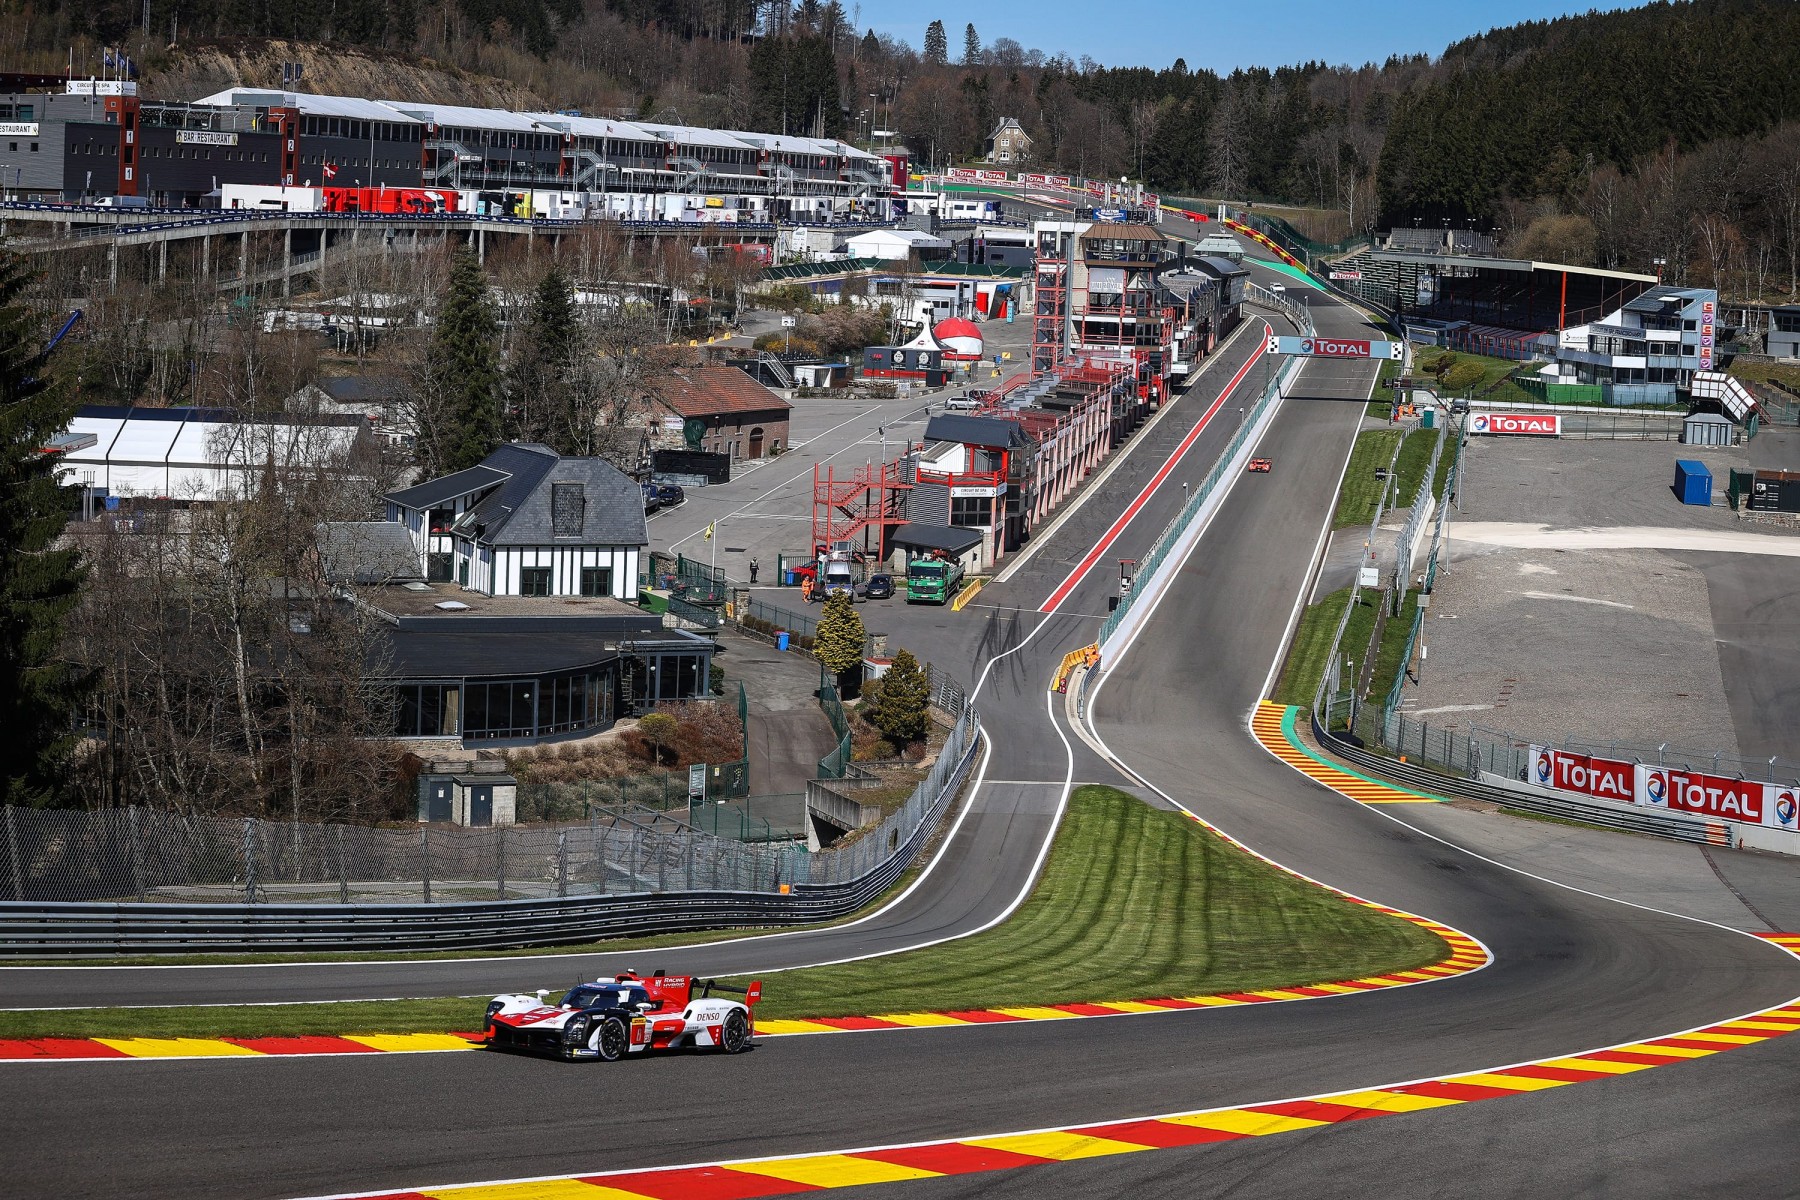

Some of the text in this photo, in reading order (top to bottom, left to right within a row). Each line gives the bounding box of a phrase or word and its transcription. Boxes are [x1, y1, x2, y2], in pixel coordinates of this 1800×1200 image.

[183, 132, 230, 144] BAR RESTAURANT
[1316, 340, 1368, 355] TOTAL
[1492, 416, 1554, 431] TOTAL
[1557, 756, 1632, 797] TOTAL
[1672, 776, 1759, 818] TOTAL
[697, 1012, 720, 1021] DENSO
